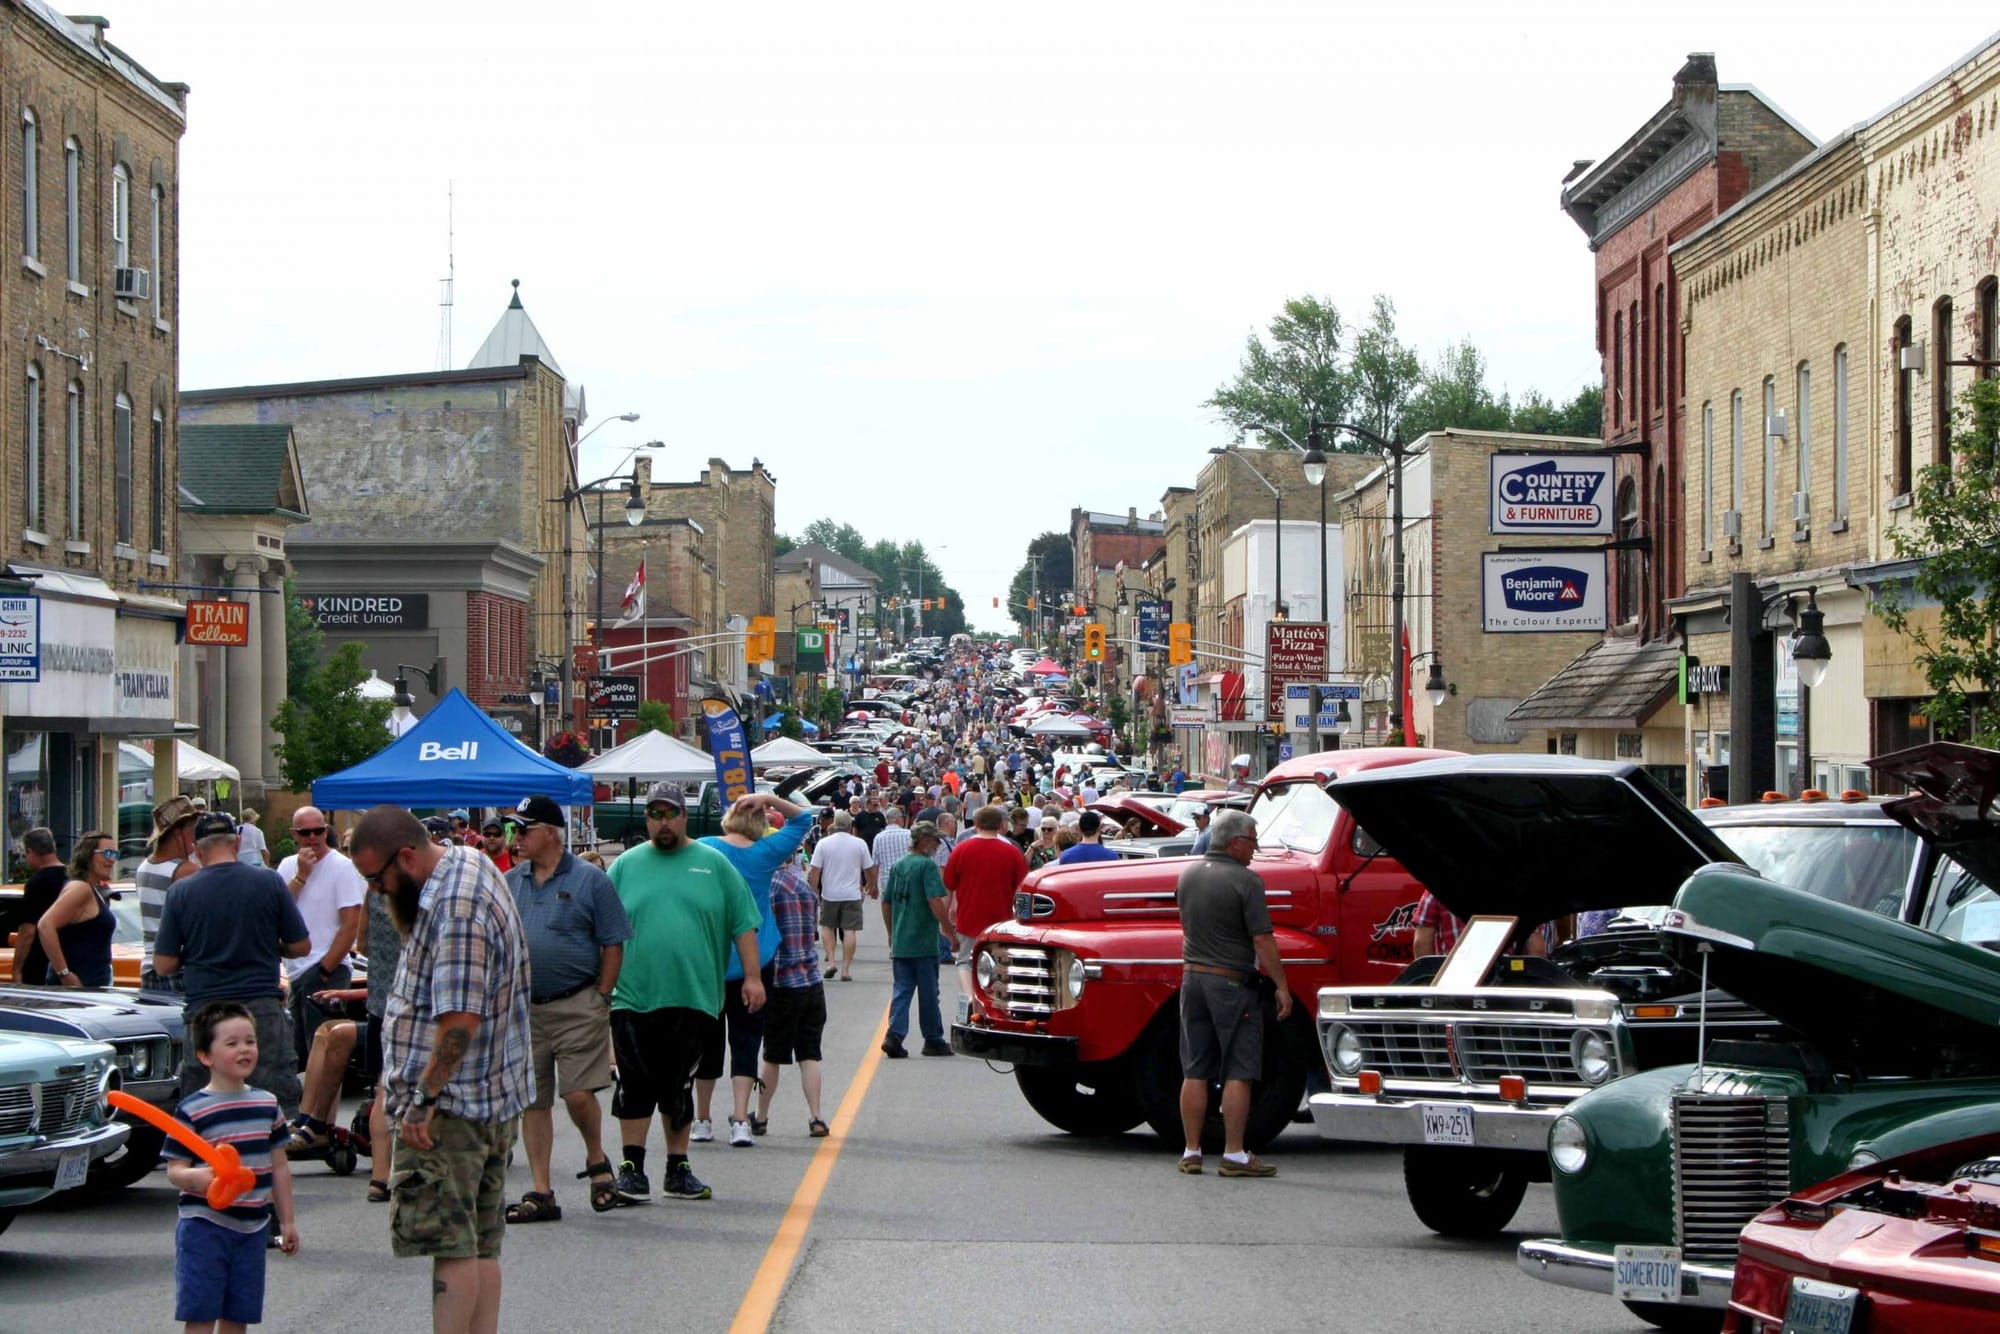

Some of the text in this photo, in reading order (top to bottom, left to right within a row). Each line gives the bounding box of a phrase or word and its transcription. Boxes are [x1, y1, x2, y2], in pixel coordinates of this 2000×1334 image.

[1507, 508, 1593, 520] & FURNITURE
[1506, 578, 1563, 592] Benjamin
[1515, 590, 1554, 601] Moore
[2, 601, 27, 611] CENTER
[318, 598, 402, 612] KINDRED
[193, 605, 243, 624] TRAIN
[318, 613, 402, 624] Credit Union
[1489, 617, 1598, 626] The Colour Experts
[190, 624, 241, 642] Cellar
[1272, 626, 1325, 640] Mattéo's
[801, 633, 822, 648] TD
[1281, 639, 1314, 650] Pizza
[1294, 662, 1300, 670] &
[1701, 665, 1720, 692] BLOCK
[122, 673, 144, 698] TRAIN
[145, 674, 169, 699] CELLAR
[611, 694, 636, 702] BAD!
[419, 741, 478, 760] Bell
[1367, 943, 1412, 959] CONS
[1373, 998, 1547, 1010] FORD
[1450, 1115, 1469, 1136] 251
[1617, 1260, 1677, 1287] SOMERTOY
